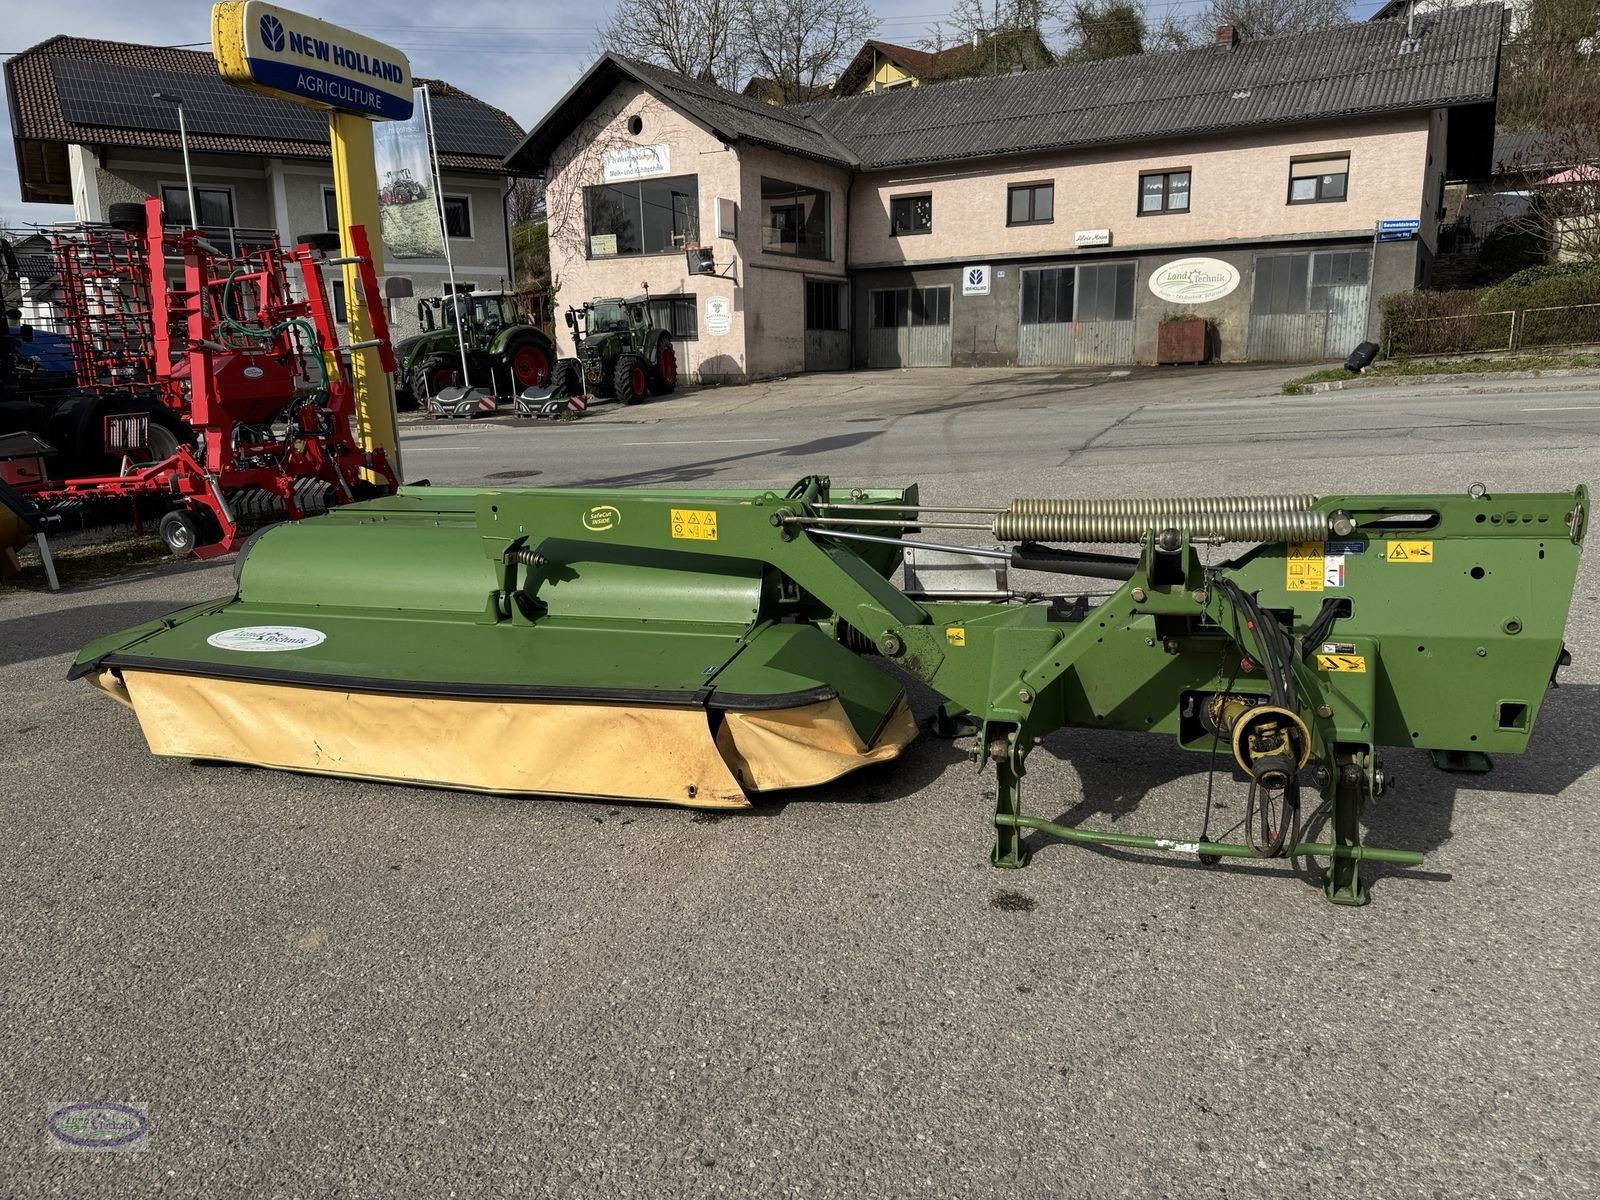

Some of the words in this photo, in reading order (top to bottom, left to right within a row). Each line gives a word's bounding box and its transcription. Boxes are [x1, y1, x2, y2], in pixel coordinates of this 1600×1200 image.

[289, 31, 330, 62] NEW
[332, 44, 403, 84] HOLLAND
[297, 73, 382, 109] AGRICULTURE
[1167, 271, 1188, 281] Land
[1194, 273, 1225, 283] Technik
[590, 511, 612, 520] SafeCut
[591, 517, 611, 525] INSIDE
[265, 635, 308, 644] Technik
